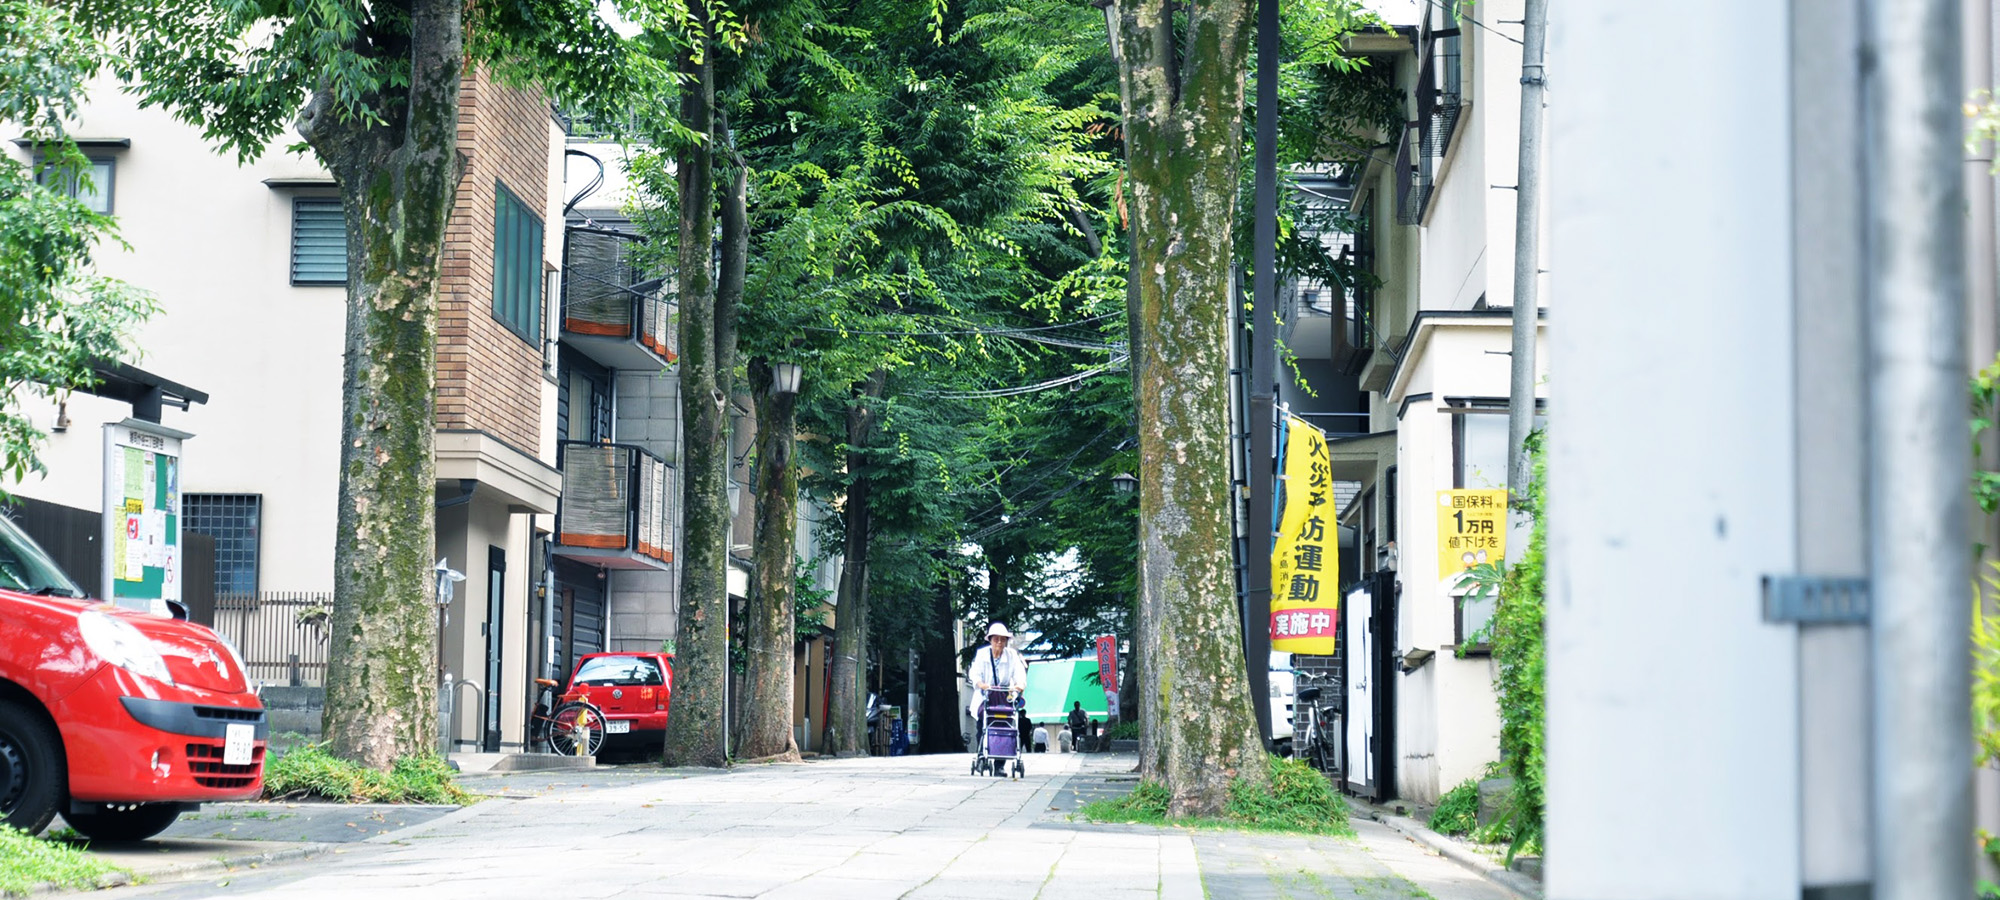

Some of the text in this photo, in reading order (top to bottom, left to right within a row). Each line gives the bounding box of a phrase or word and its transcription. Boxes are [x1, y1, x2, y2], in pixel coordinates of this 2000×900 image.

[1453, 495, 1493, 509] 国保料
[1453, 510, 1494, 534] 1万円
[1448, 536, 1498, 548] 値下げを
[1275, 611, 1330, 636] 実施中
